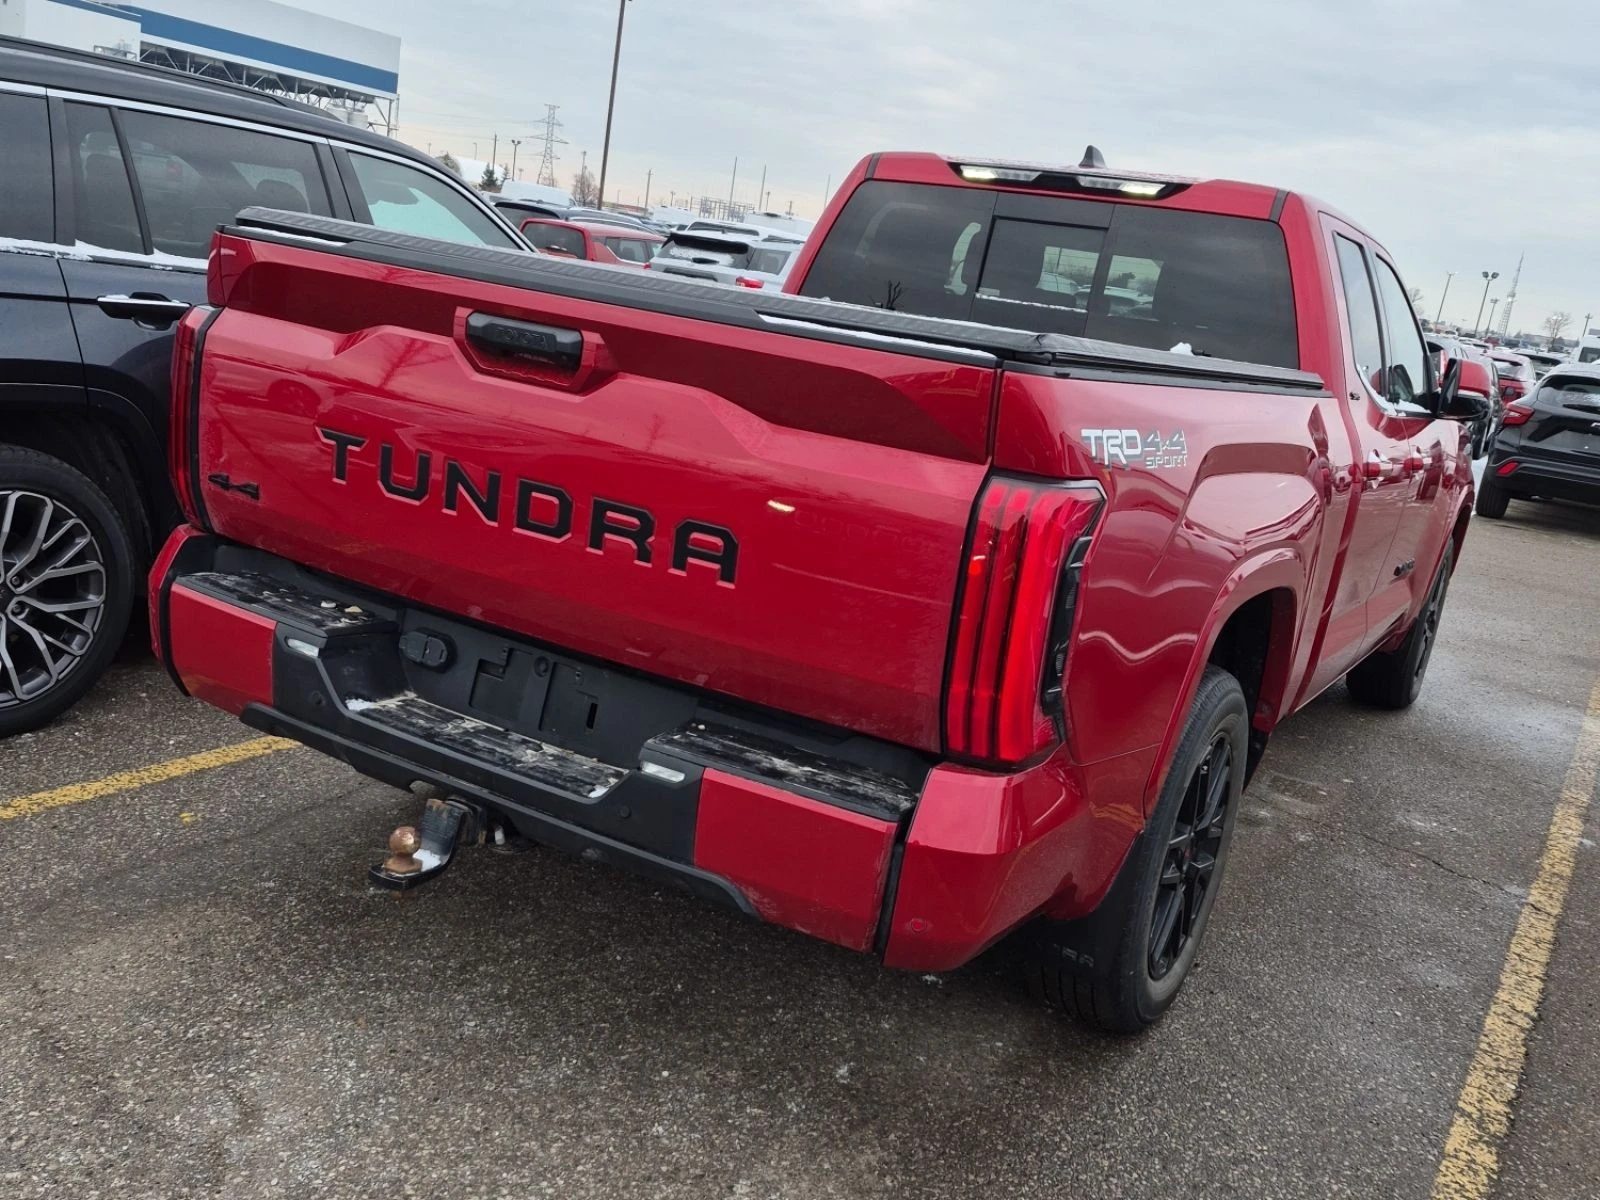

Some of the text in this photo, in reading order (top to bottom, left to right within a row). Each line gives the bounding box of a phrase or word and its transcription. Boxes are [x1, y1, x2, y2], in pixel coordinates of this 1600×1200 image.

[495, 325, 549, 350] TOYOTA
[1080, 428, 1143, 469] TRD
[1145, 454, 1188, 469] SPORT
[315, 427, 739, 589] TUNDRA
